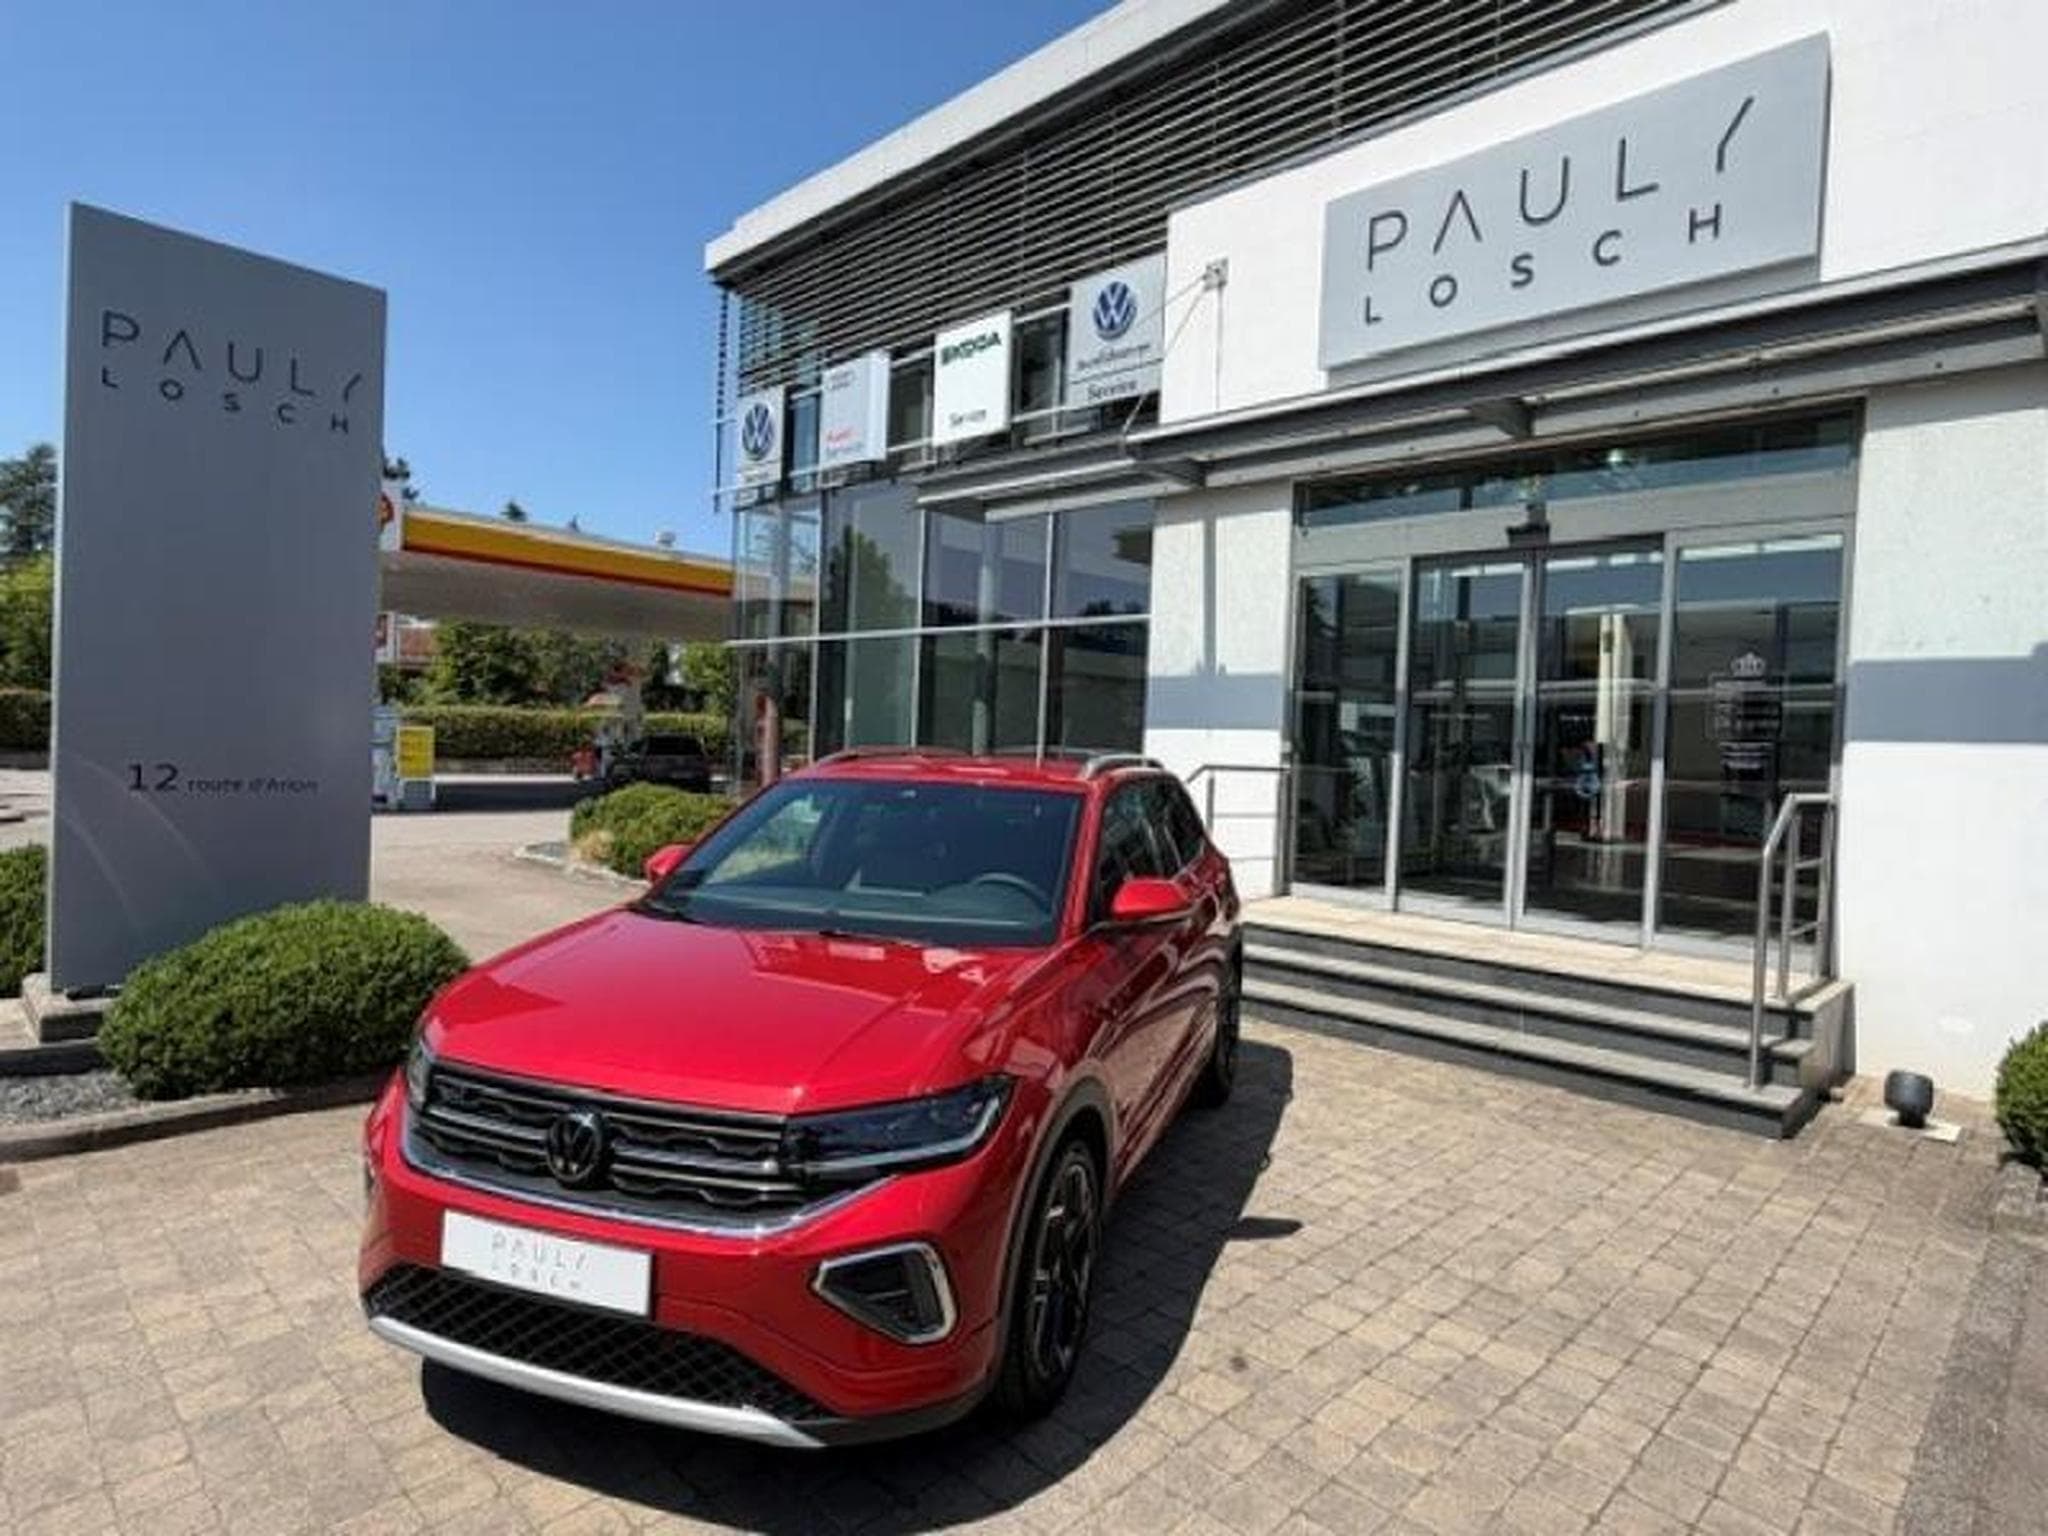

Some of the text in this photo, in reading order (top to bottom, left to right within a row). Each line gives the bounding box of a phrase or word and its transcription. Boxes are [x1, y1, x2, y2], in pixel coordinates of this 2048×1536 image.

[1368, 97, 1755, 271] PAULY
[1364, 203, 1722, 326] LOSCH
[101, 309, 362, 402] PAULY
[101, 366, 349, 434] LOSCH
[128, 763, 179, 792] 12
[187, 778, 242, 797] route
